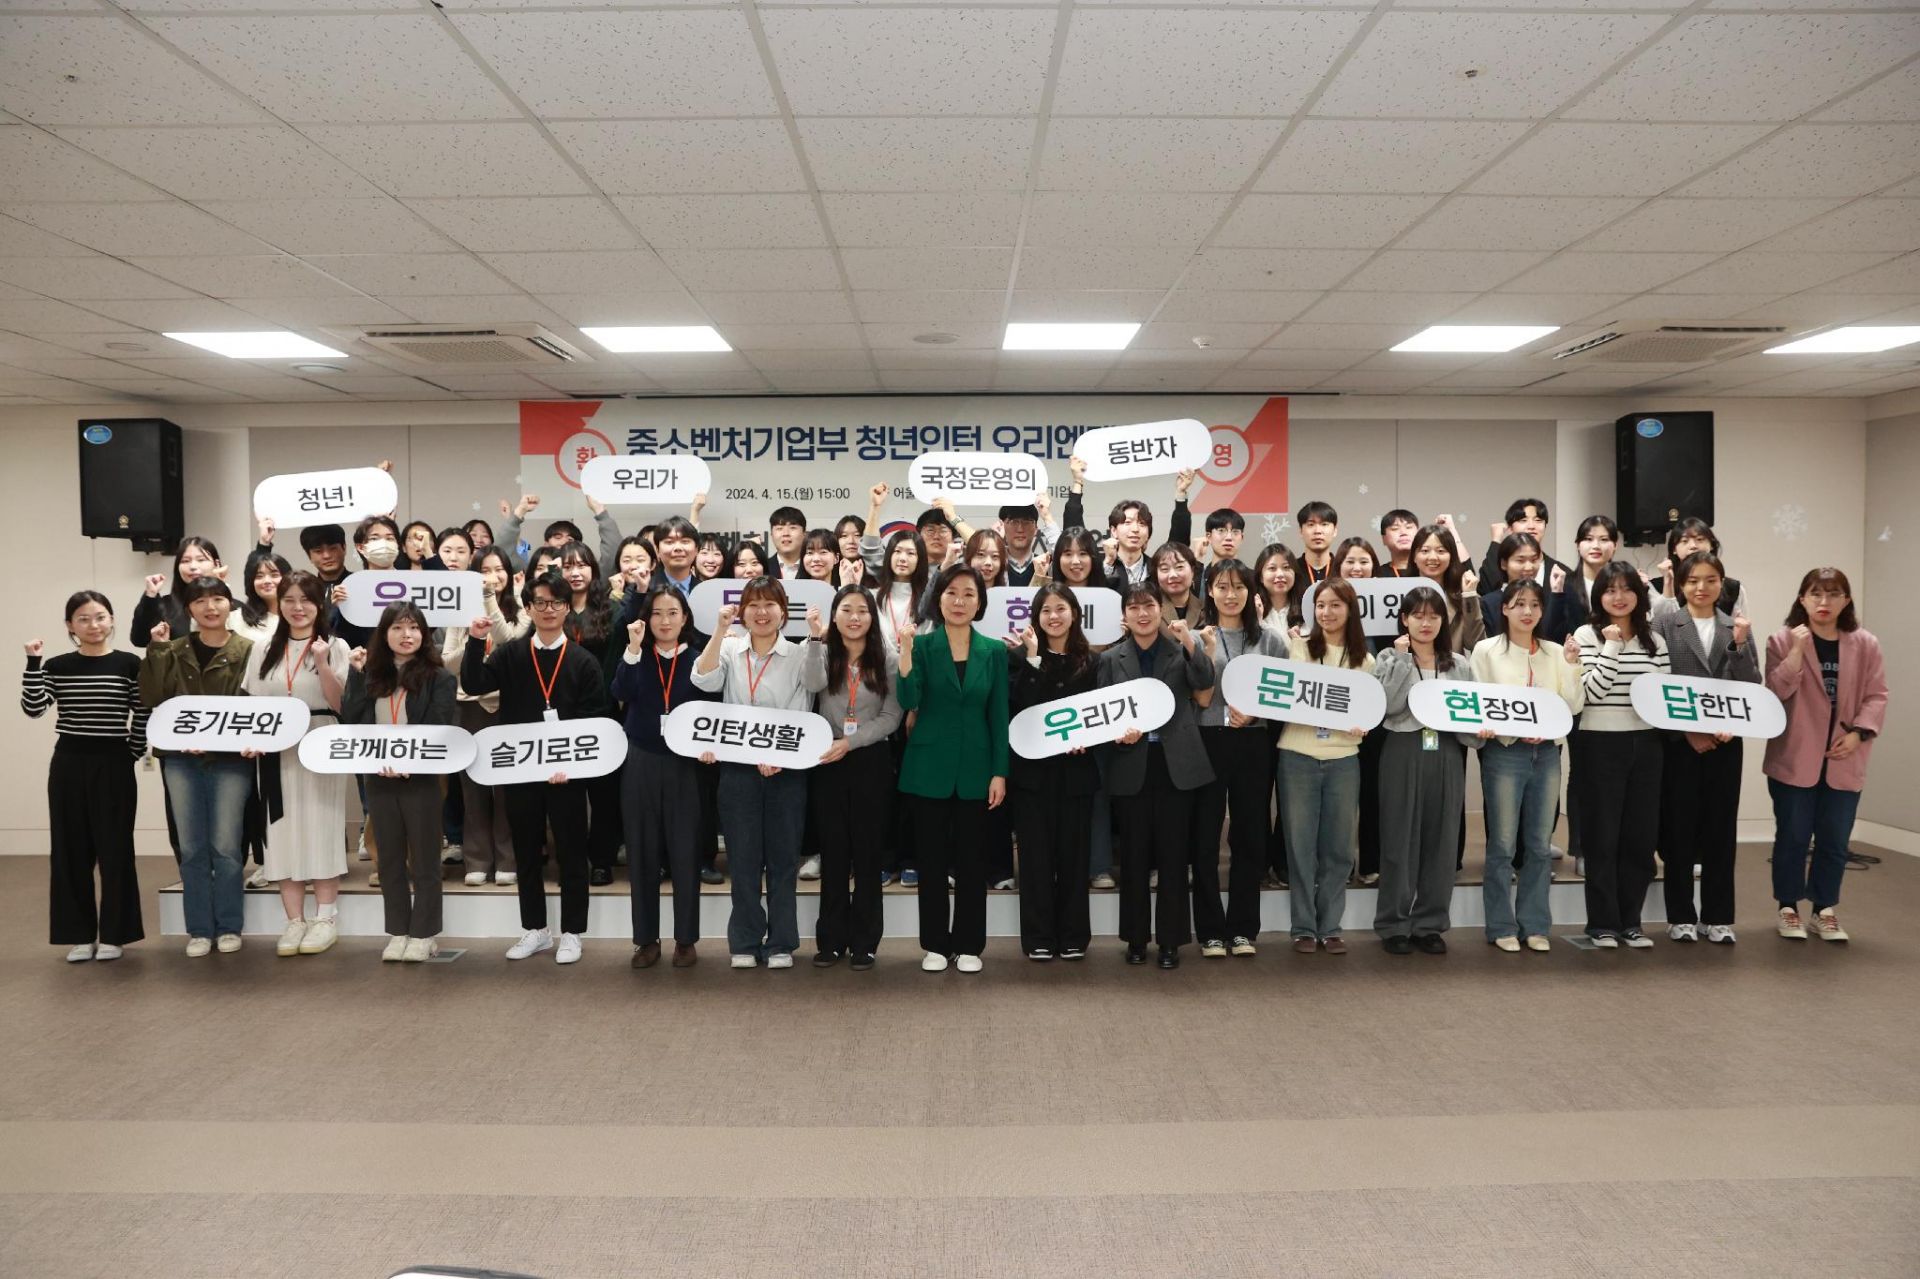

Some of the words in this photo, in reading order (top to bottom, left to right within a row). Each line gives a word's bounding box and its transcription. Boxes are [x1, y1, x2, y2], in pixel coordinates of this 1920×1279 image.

[626, 427, 849, 461] 중소벤처기업부
[856, 425, 981, 460] 청년인턴
[992, 425, 1115, 460] 오리엔
[1108, 435, 1178, 465] 동반자
[1212, 443, 1232, 467] 영
[612, 468, 678, 490] 우리가
[921, 466, 1036, 491] 국정운영의
[298, 486, 354, 511] 청년!
[725, 488, 758, 500] 2024.
[818, 488, 850, 500] 15:00
[1257, 666, 1351, 713] 문제를
[1661, 684, 1752, 722] 답한다
[1044, 695, 1138, 741] 우리가
[1444, 689, 1538, 724] 현장의
[172, 710, 283, 737] 중기부와
[691, 716, 806, 753] 인턴생활
[329, 738, 449, 760] 함께하는
[490, 734, 600, 769] 슬기로운
